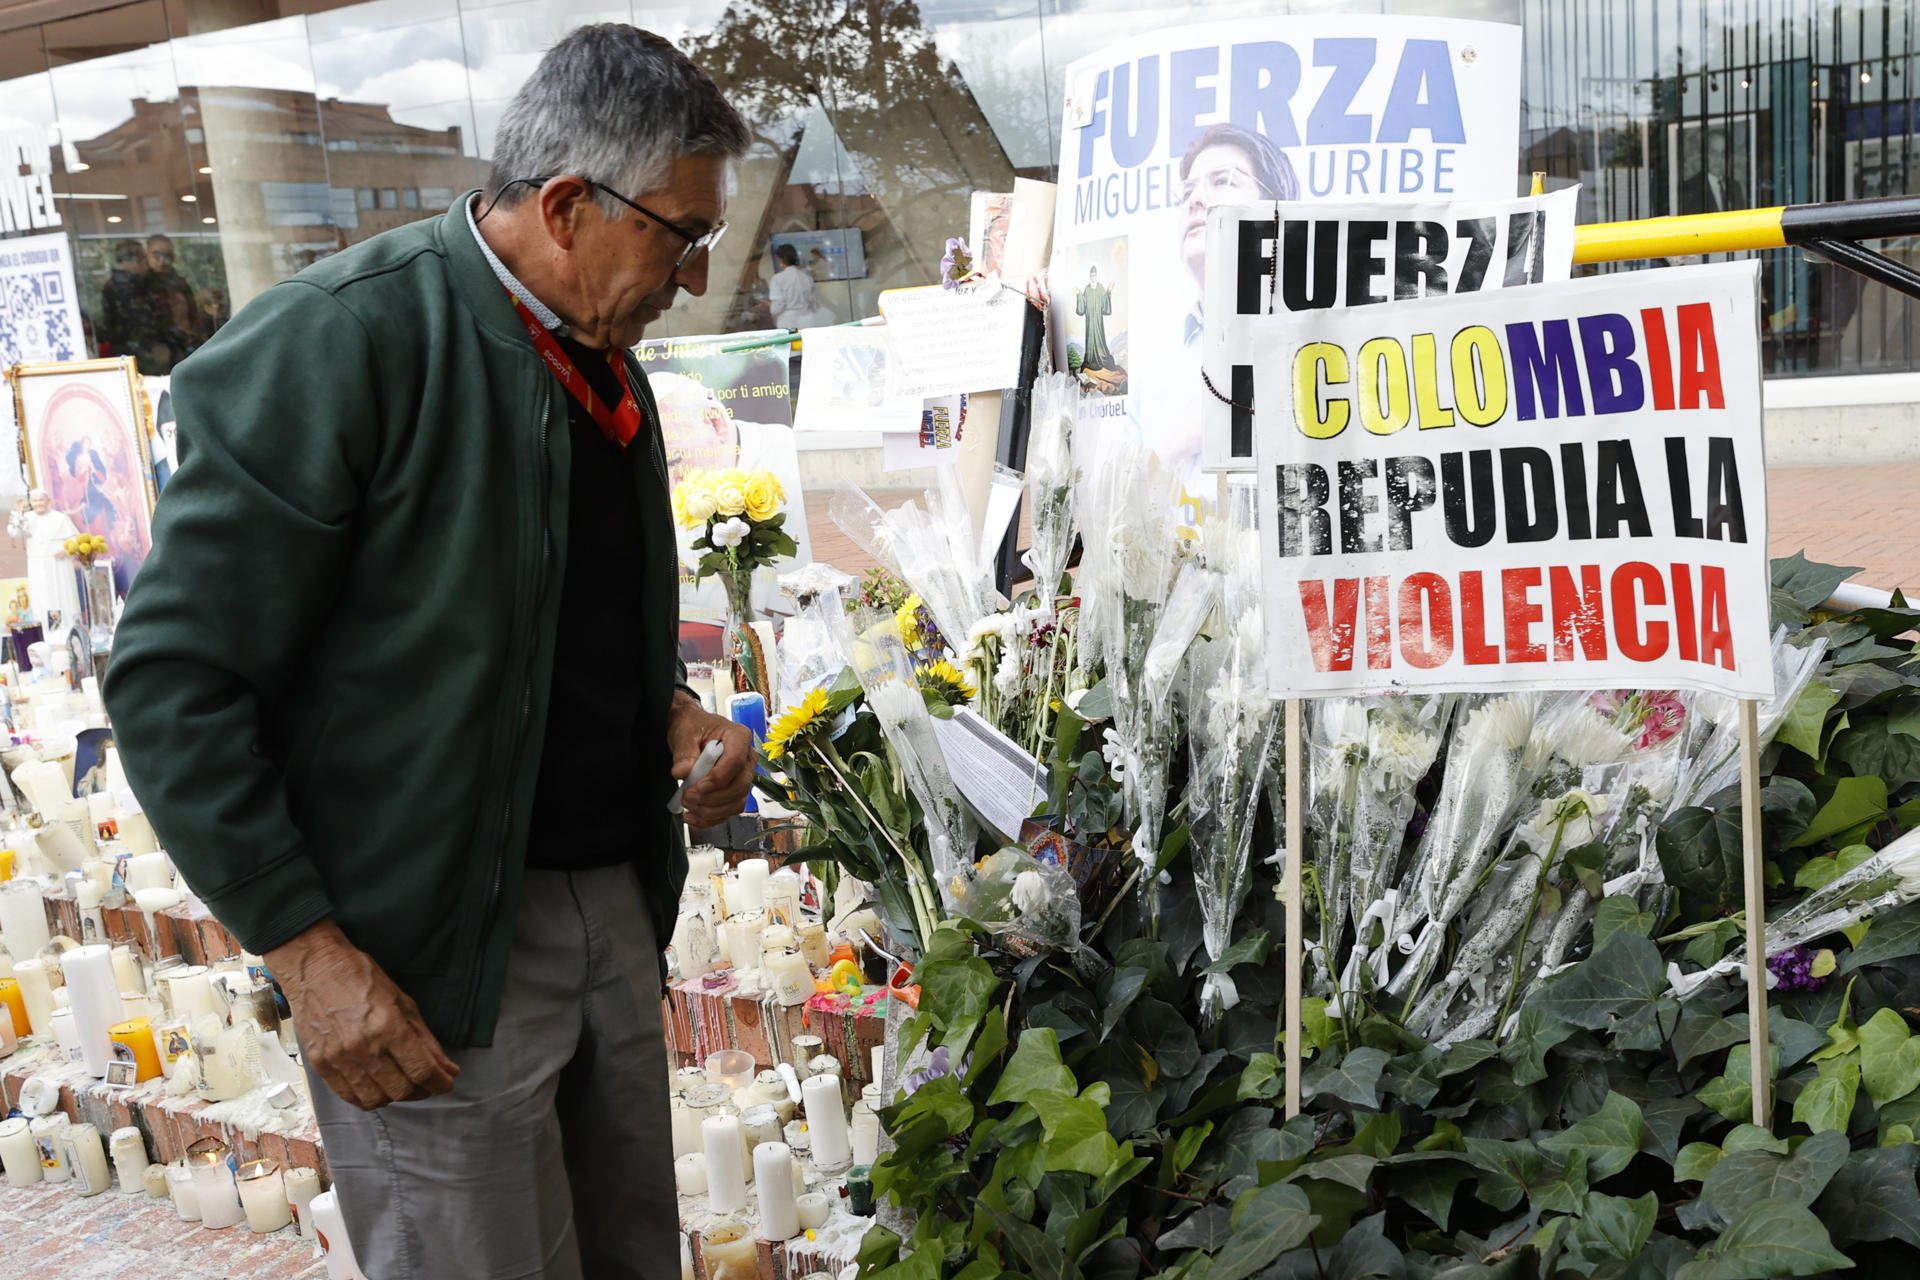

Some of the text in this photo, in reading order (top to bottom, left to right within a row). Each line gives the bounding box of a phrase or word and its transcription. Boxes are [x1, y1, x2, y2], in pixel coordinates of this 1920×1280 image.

[1078, 38, 1467, 180] FUERZA
[1309, 148, 1456, 197] URIBE
[1236, 211, 1547, 315] FUERZA
[636, 341, 656, 361] de
[717, 381, 789, 400] por ti amigo
[1291, 301, 1726, 440] COLOMBIA
[933, 406, 952, 450] FUERZA
[1276, 436, 1748, 558] REPUDIA LA
[1298, 561, 1737, 673] VIOLENCIA
